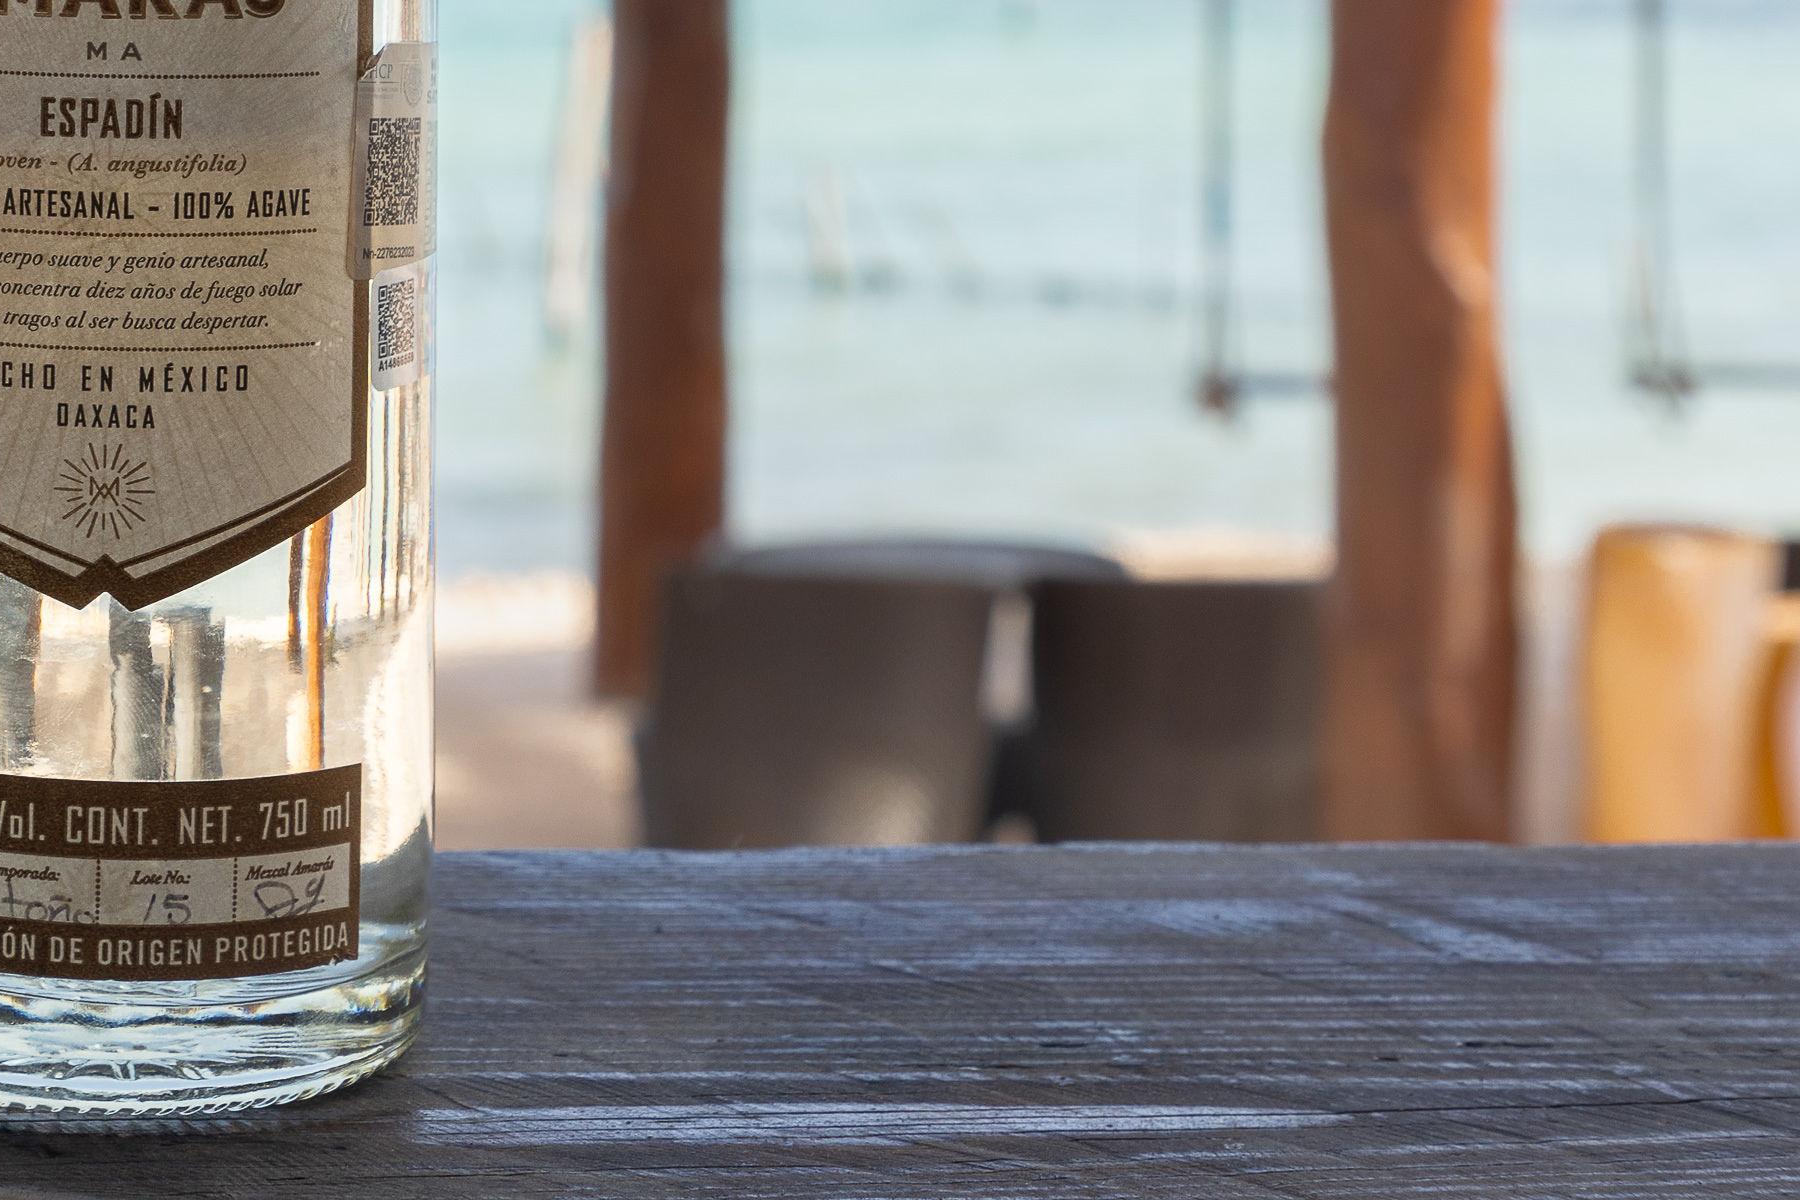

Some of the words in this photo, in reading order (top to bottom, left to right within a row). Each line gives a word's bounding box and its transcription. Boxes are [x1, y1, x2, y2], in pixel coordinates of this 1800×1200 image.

[40, 92, 183, 140] ESPADÍN
[68, 153, 97, 175] (A.
[107, 153, 248, 179] angustifolia)
[3, 187, 136, 220] ARTESANAL
[173, 192, 234, 220] 100%
[247, 188, 311, 218] AGAVE
[48, 254, 103, 267] suave
[105, 256, 120, 273] y
[123, 252, 175, 274] genio
[180, 248, 269, 269] artesanal,
[86, 280, 126, 299] diez
[131, 283, 175, 299] años
[180, 281, 202, 299] de
[202, 281, 254, 304] fuego
[259, 278, 302, 297] solar
[4, 311, 60, 331] tragos
[65, 311, 85, 328] al
[89, 316, 119, 329] ser
[122, 312, 175, 329] busca
[181, 312, 268, 334] despertar.
[82, 366, 113, 391] EN
[139, 362, 249, 393] MÉXICO
[57, 403, 155, 429] OAXACA
[67, 805, 158, 845] CONT.
[180, 806, 242, 845] NET.
[260, 799, 307, 840] 750
[323, 791, 350, 831] ml
[130, 870, 162, 885] Lote
[245, 862, 292, 881] Mezcal
[291, 855, 335, 876] Amarás
[50, 936, 83, 964] DE
[98, 938, 201, 966] ORIGEN
[215, 922, 348, 964] PROTEGIDA
